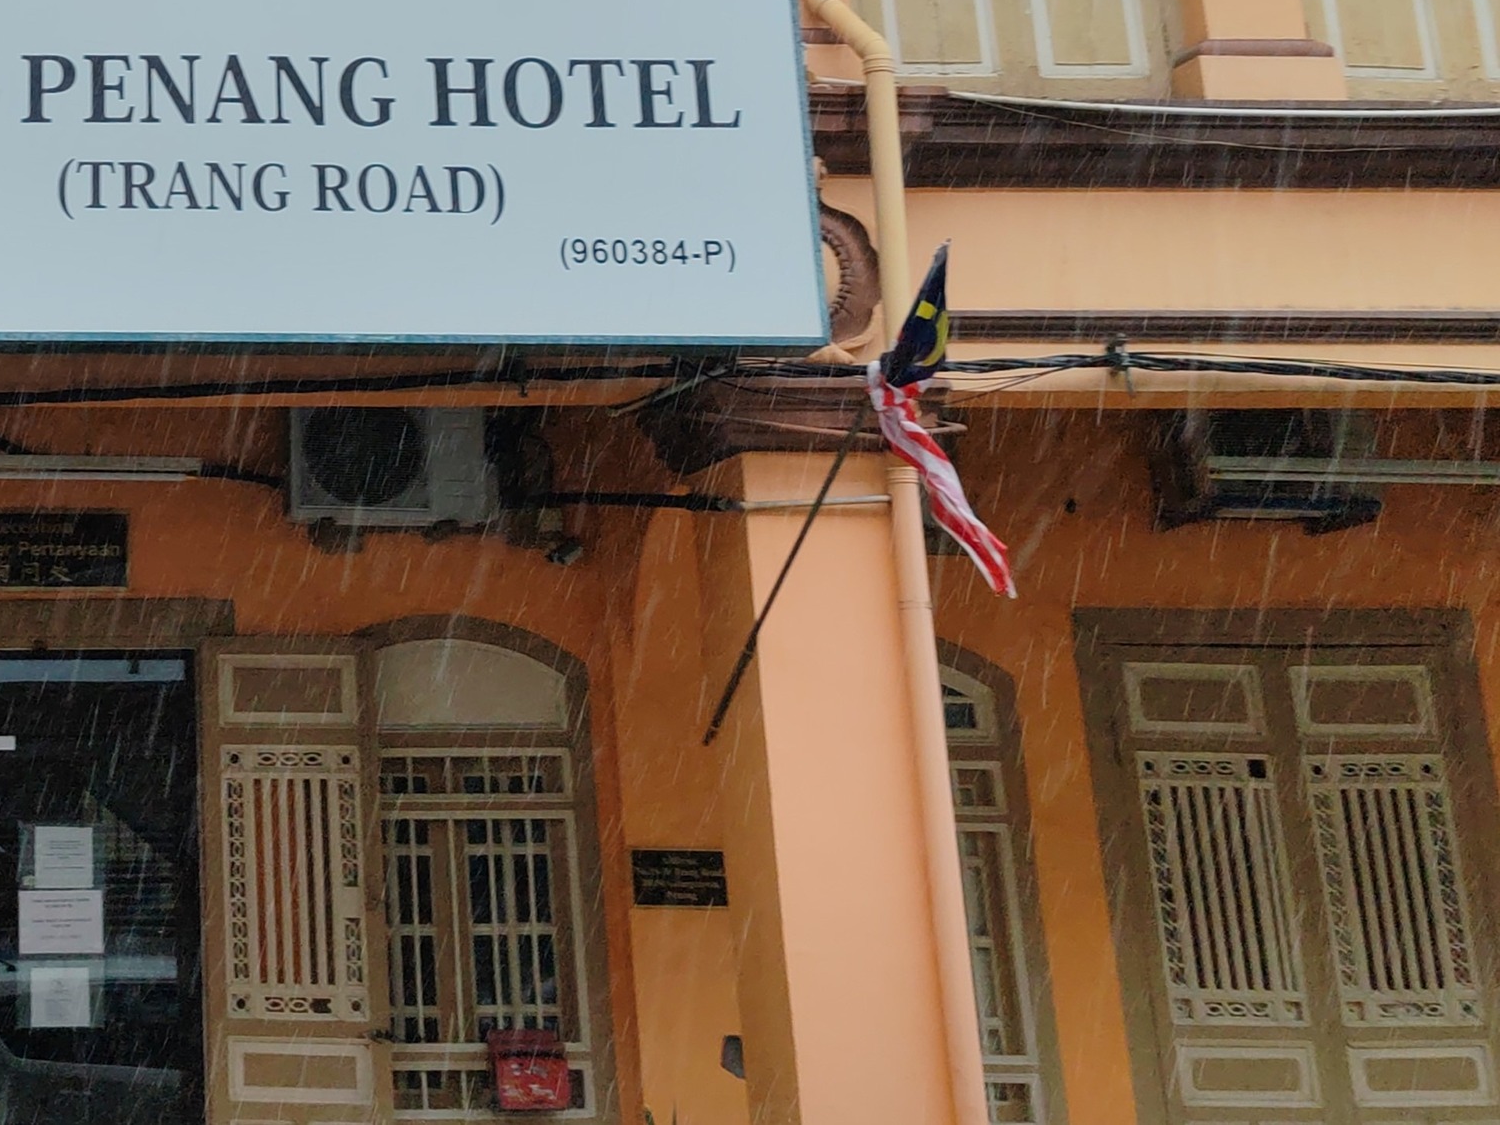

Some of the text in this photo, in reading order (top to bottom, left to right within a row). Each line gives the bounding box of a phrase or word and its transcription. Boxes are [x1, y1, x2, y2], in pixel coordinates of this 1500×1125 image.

[20, 54, 396, 128] PENANG
[426, 57, 741, 129] HOTEL
[58, 158, 505, 225] (TRANG ROAD)
[560, 238, 736, 273] (960384-P)
